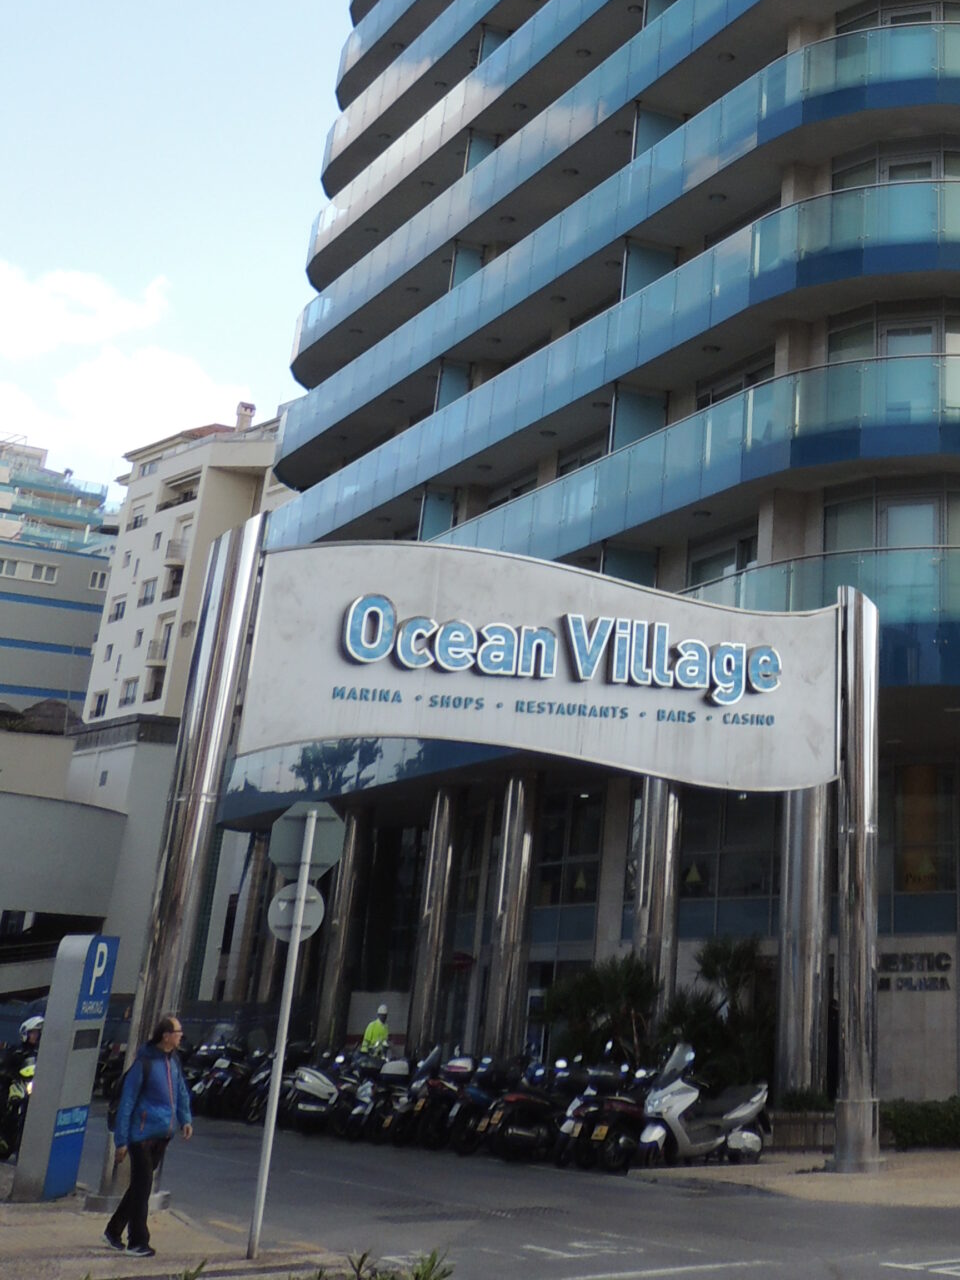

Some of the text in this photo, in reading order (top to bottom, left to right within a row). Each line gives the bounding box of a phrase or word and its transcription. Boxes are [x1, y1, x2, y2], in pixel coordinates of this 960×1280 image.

[342, 593, 782, 707] Ocean Village
[333, 686, 775, 727] MARINA SHOPS RESTAURANTS BARS CASINO
[88, 941, 109, 996] P
